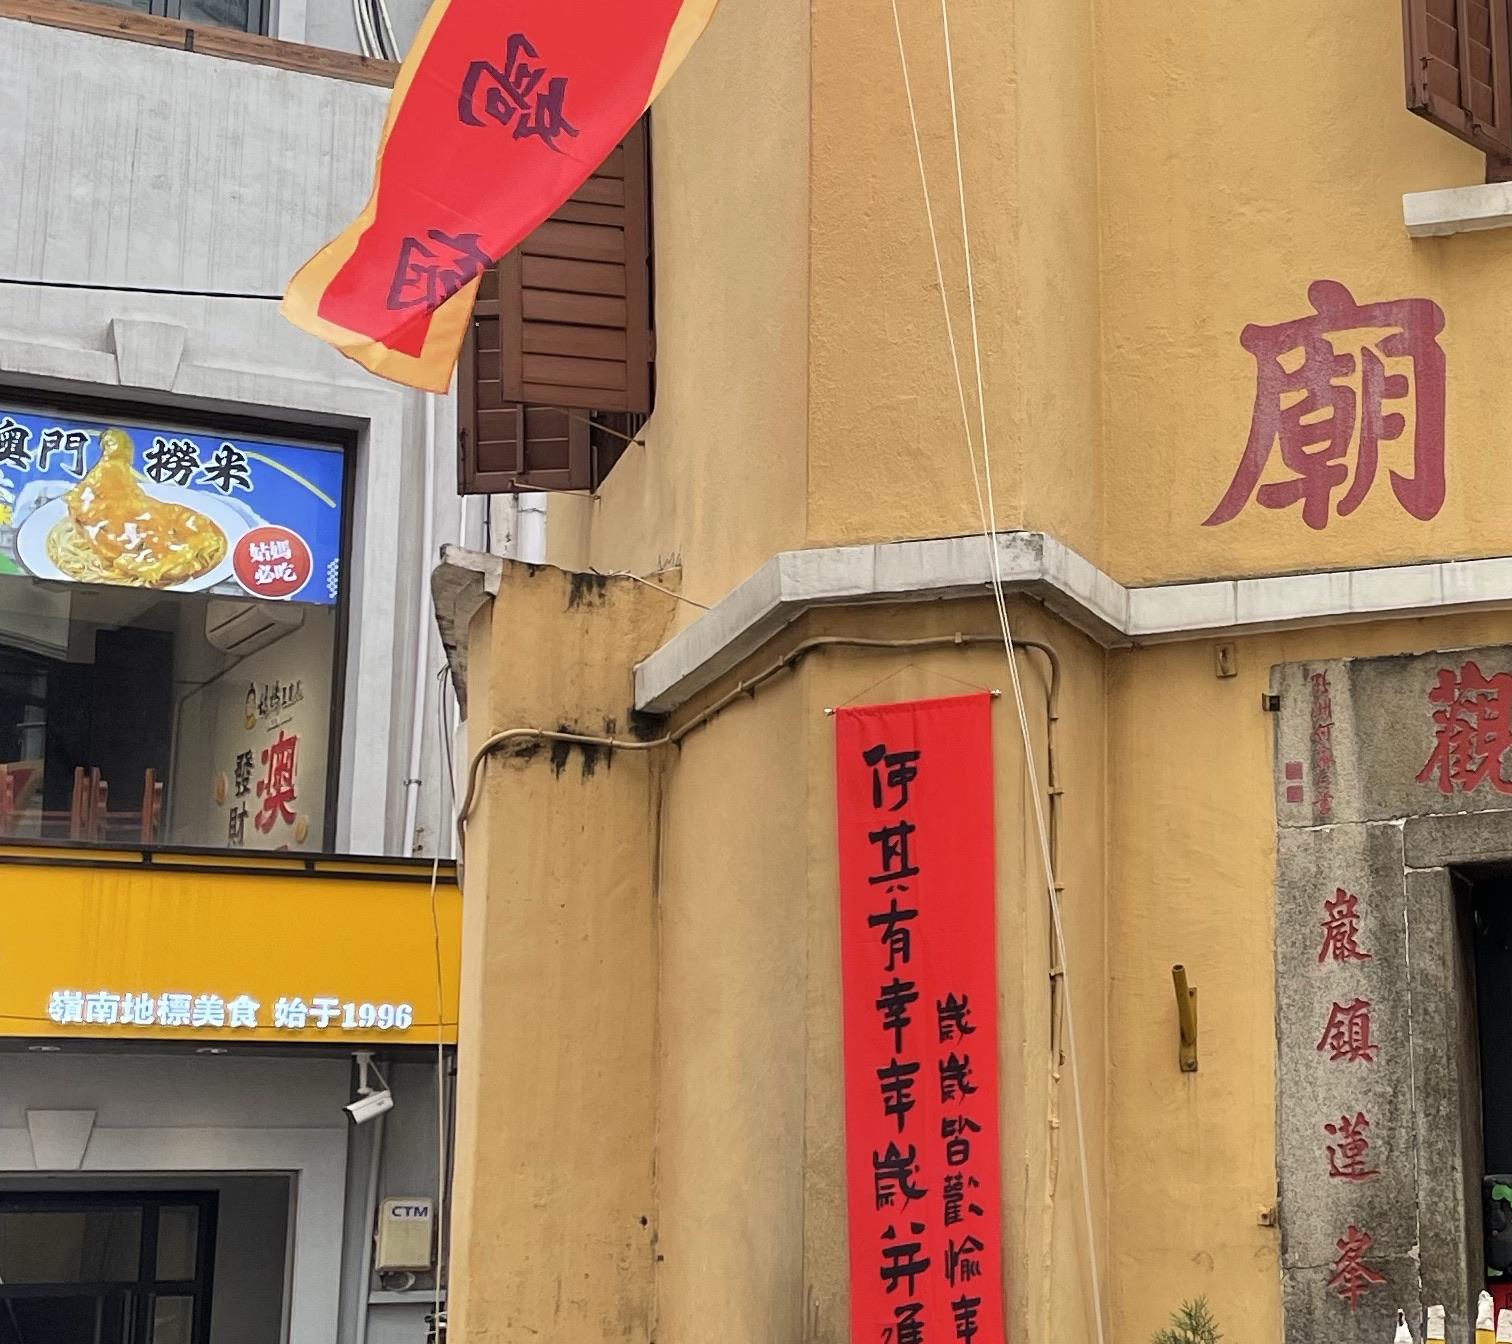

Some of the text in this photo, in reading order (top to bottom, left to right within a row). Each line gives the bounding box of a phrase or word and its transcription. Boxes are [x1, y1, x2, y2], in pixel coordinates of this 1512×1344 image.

[145, 439, 253, 493] 撈米
[248, 539, 293, 562] 姑媽
[255, 560, 298, 586] 必吃
[273, 995, 414, 1030] 始于1996
[391, 1206, 428, 1217] CTM
